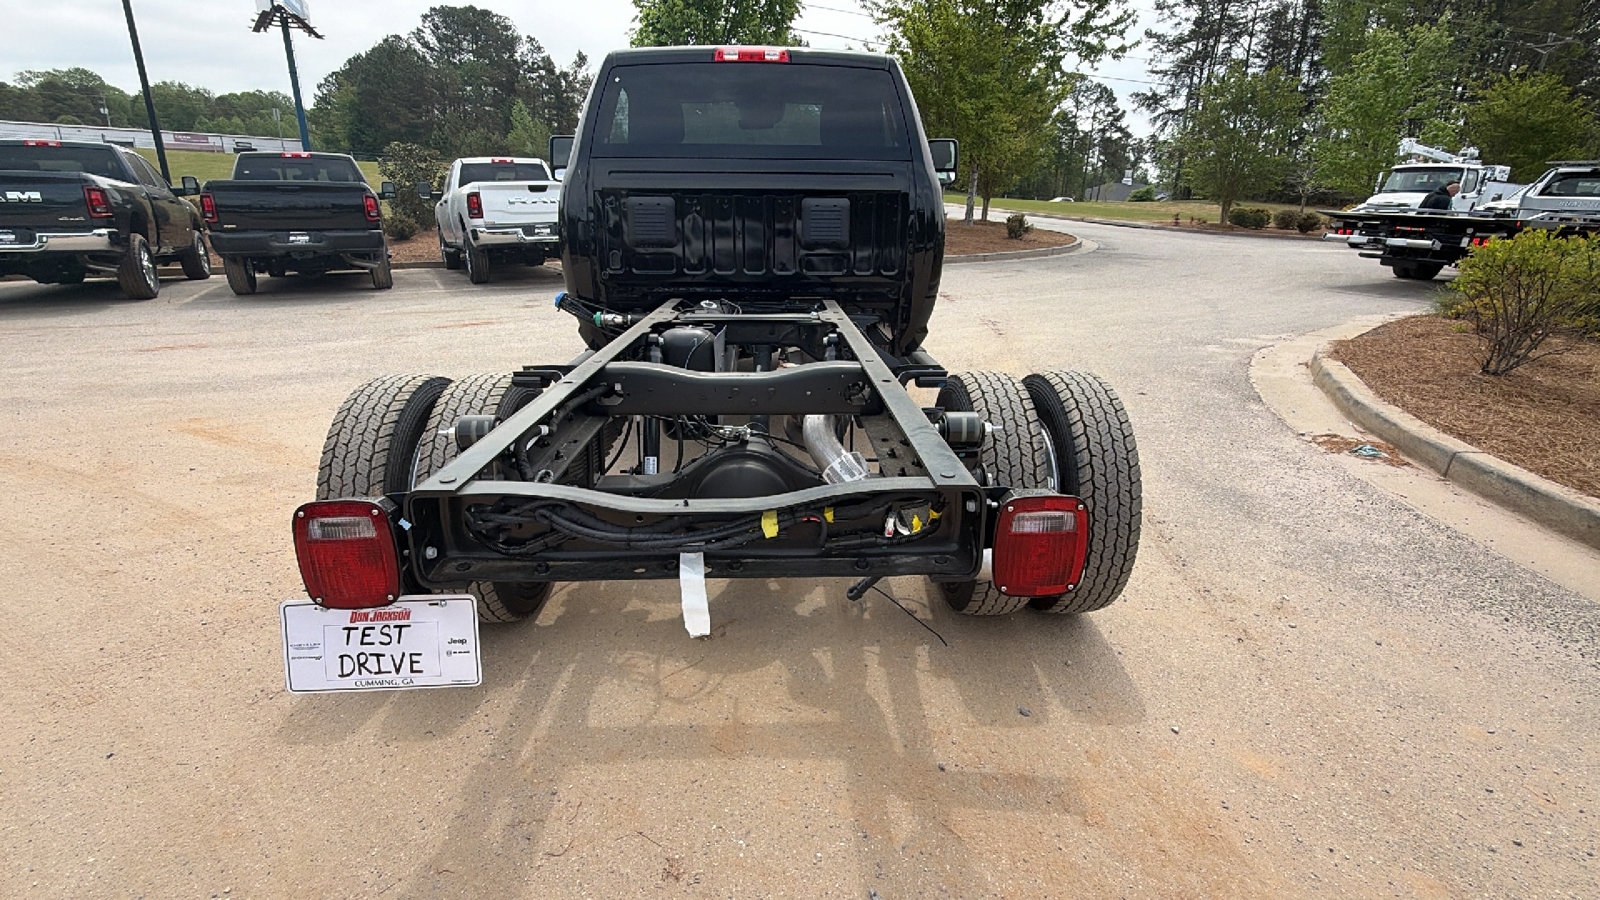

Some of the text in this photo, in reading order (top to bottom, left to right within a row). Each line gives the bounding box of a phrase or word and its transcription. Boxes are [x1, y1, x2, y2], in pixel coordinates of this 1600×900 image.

[350, 610, 411, 624] DON JACKSON
[342, 624, 411, 646] TEST
[447, 637, 467, 645] Jeep
[338, 651, 424, 678] DRIVE
[354, 678, 414, 688] CUMMING, GA
